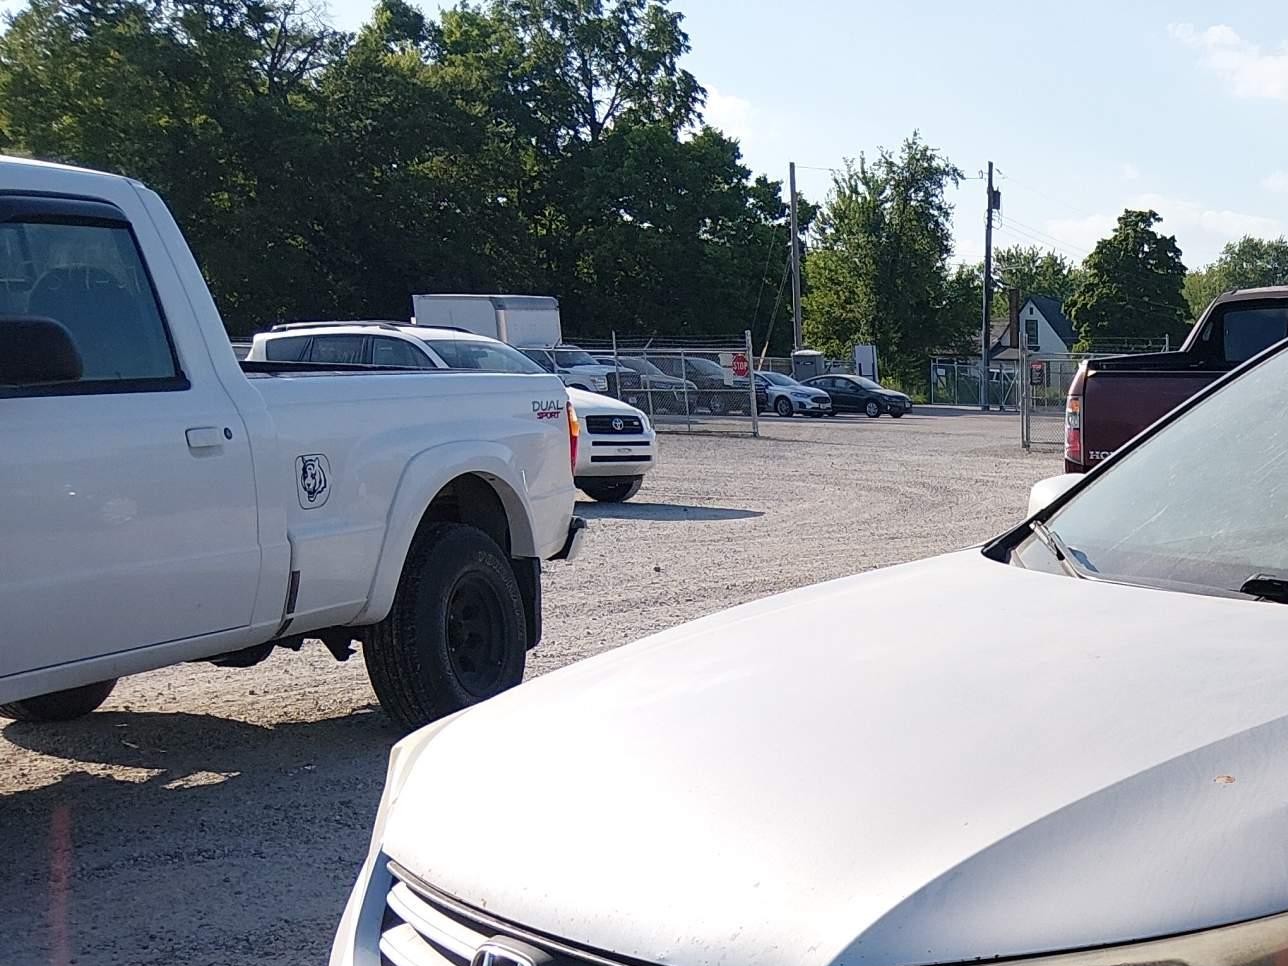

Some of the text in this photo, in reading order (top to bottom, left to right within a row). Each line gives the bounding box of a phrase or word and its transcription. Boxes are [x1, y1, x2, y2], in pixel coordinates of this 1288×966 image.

[733, 361, 748, 370] STOP
[531, 400, 564, 412] DUAL
[537, 411, 561, 420] SPORT
